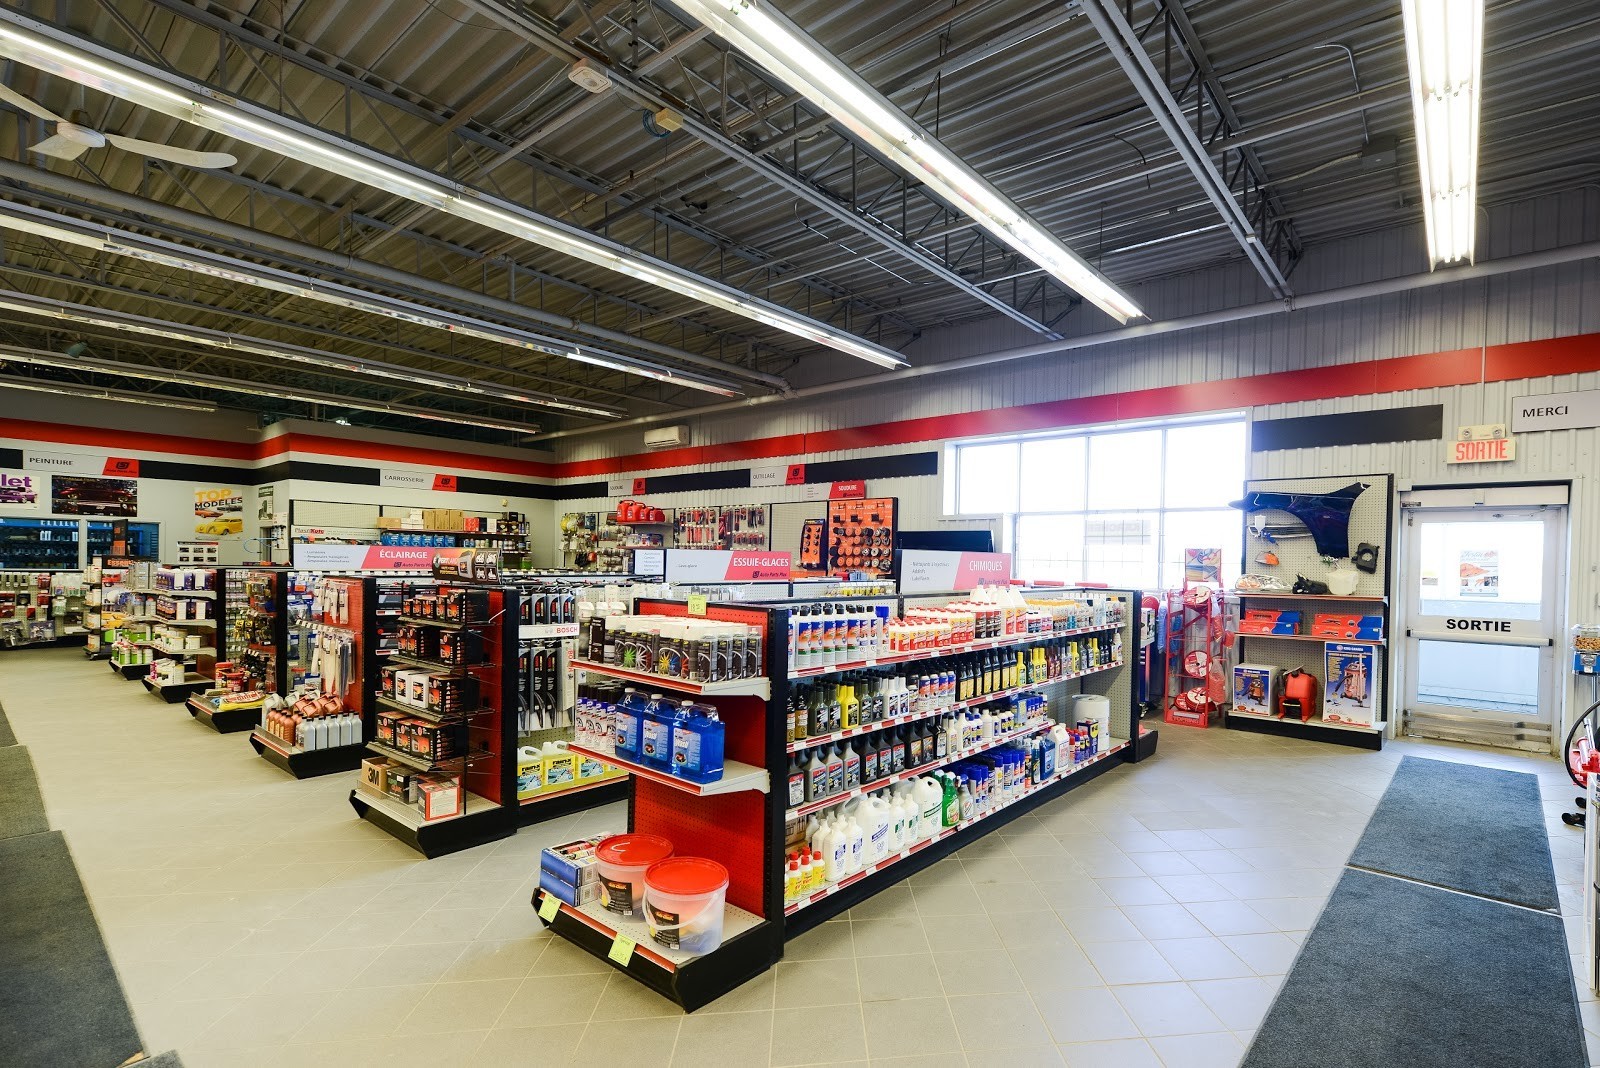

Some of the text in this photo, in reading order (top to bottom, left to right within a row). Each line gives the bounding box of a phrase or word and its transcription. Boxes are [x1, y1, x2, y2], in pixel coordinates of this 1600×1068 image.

[1522, 405, 1568, 418] MERCI
[1455, 440, 1508, 461] SORTIE
[29, 457, 74, 466] PEINTURE
[384, 474, 425, 483] CARROSSERIE
[753, 472, 776, 480] OUTILLAGE
[195, 488, 232, 503] TOP
[379, 549, 428, 559] ÉCLAIRAGE
[733, 556, 789, 569] ESSUIE-GLACES
[969, 560, 1003, 572] CHIMIQUES
[556, 626, 578, 634] BOSCH
[1446, 618, 1512, 633] SORTIE
[368, 766, 380, 787] 3M
